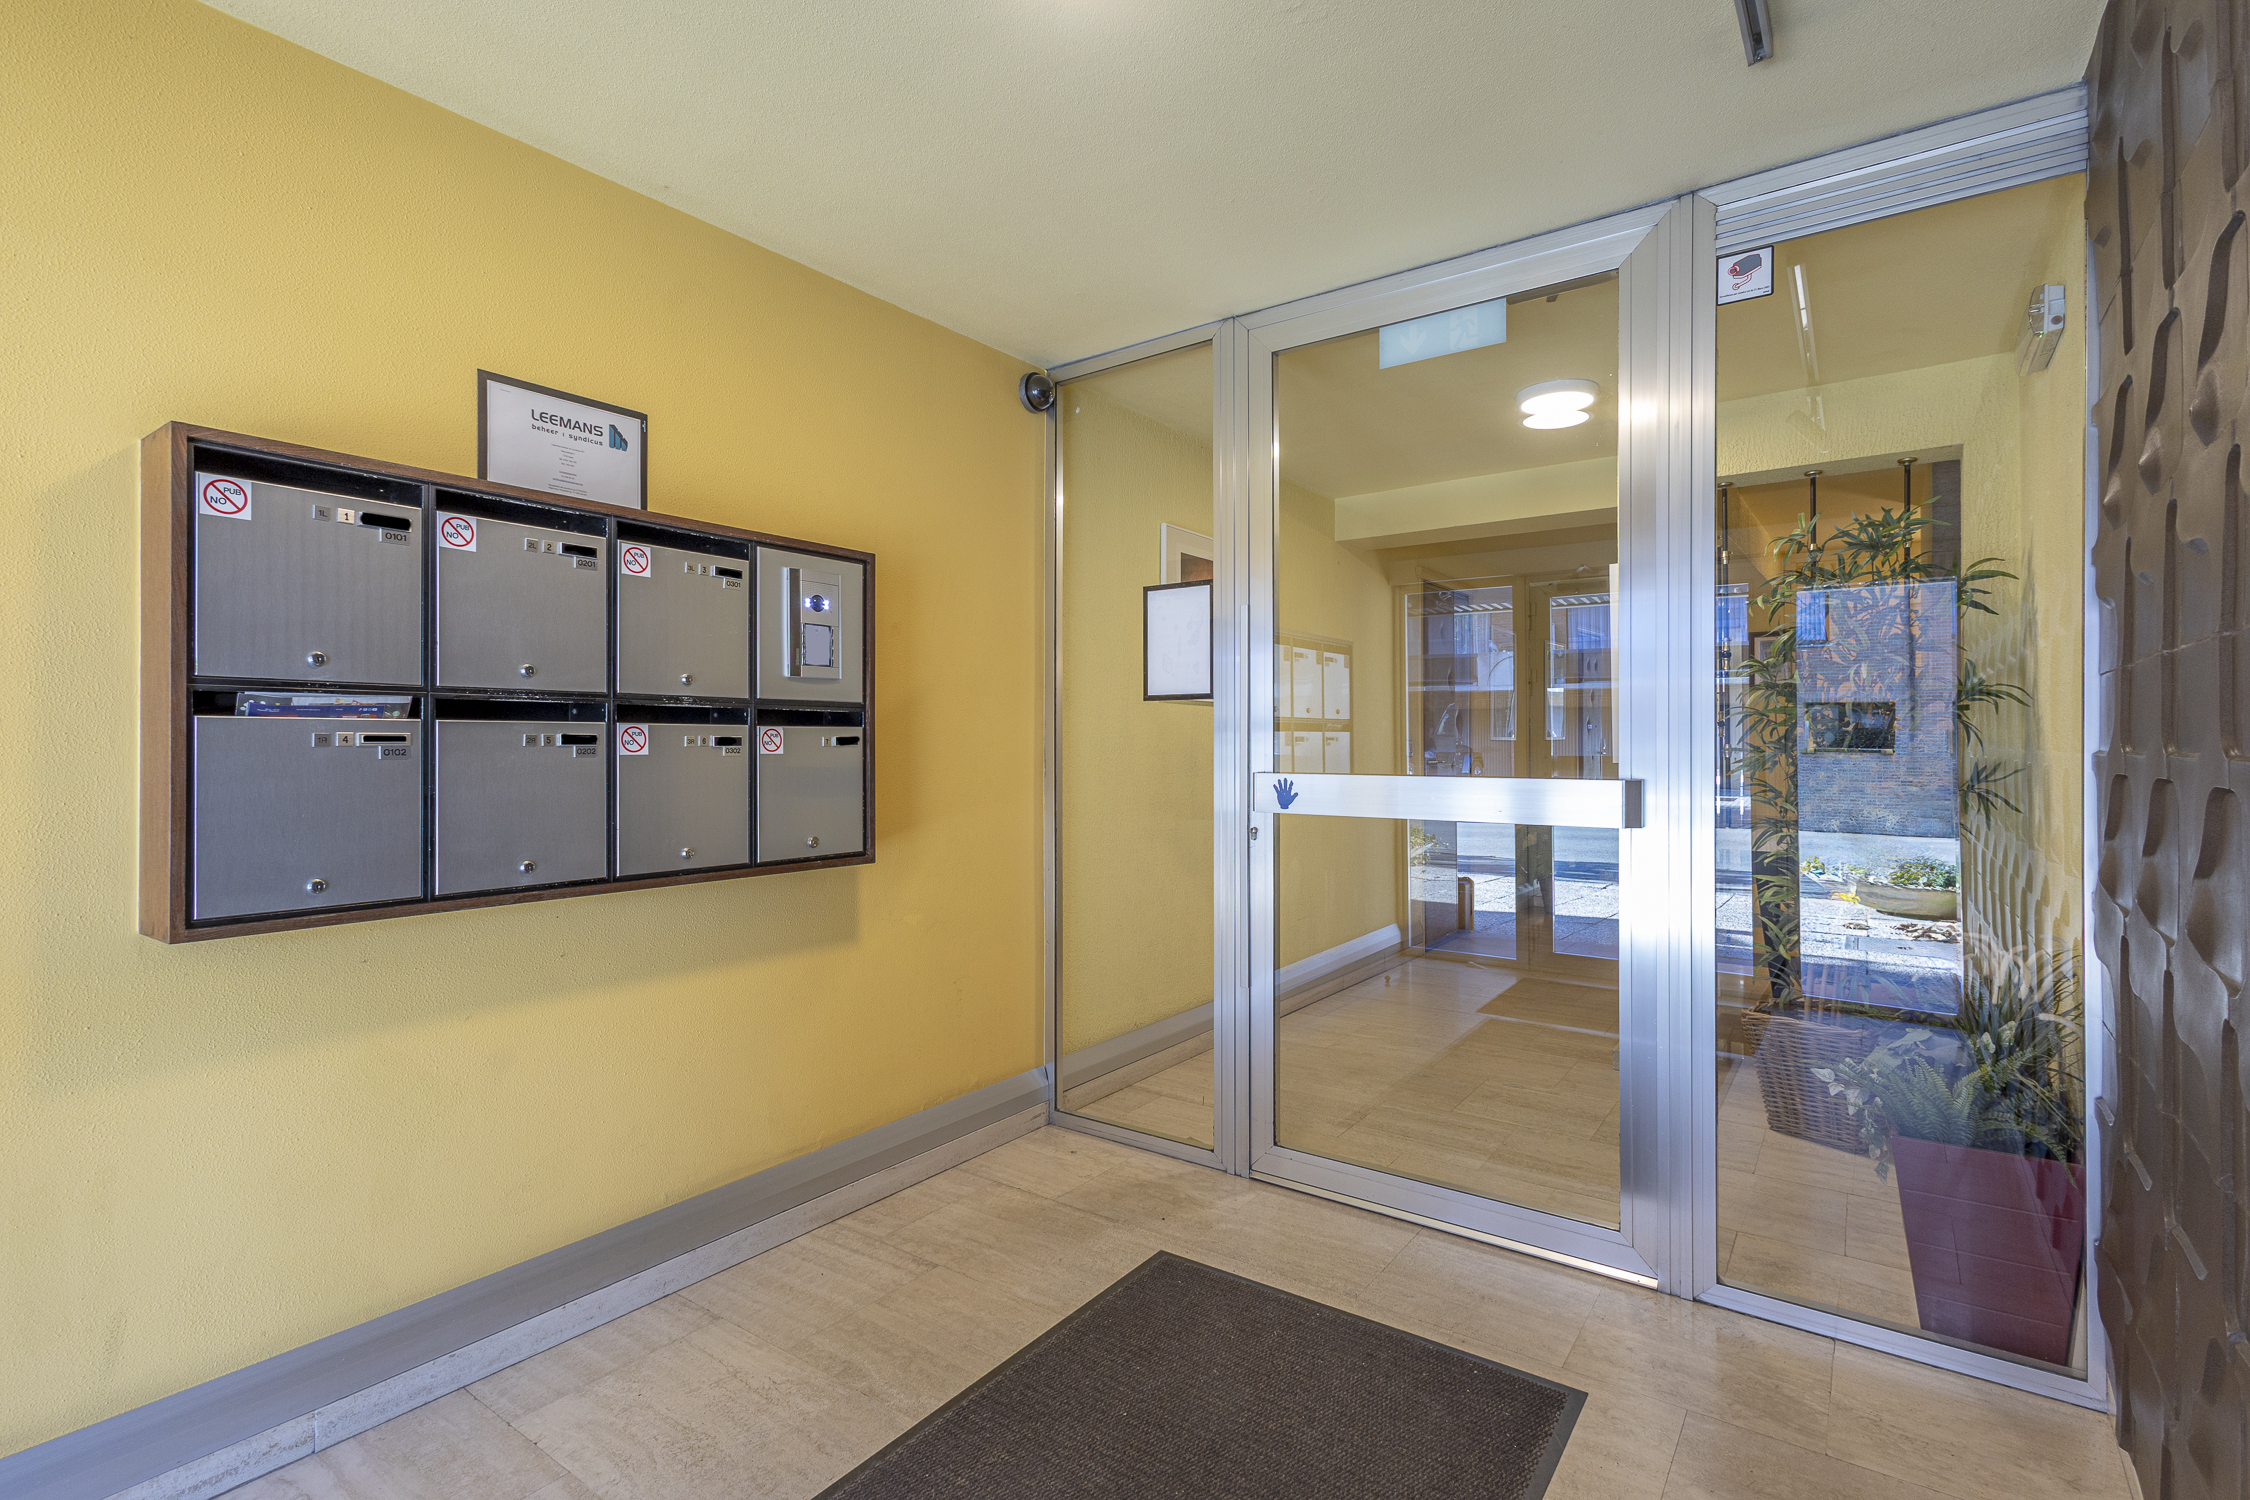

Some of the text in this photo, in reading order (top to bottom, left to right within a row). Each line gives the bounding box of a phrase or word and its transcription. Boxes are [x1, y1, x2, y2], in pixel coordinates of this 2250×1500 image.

[531, 408, 604, 437] LEEMANS
[532, 423, 604, 446] beheer syndicus
[223, 486, 242, 496] PUB
[210, 495, 227, 505] NO
[318, 509, 328, 518] 1L
[344, 512, 349, 521] 1
[456, 523, 470, 531] PUB
[385, 532, 407, 542] 0101
[446, 531, 459, 539] NO
[528, 541, 537, 550] 2L
[546, 543, 552, 551] 2
[633, 551, 645, 559] PUB
[577, 558, 596, 568] 0201
[726, 580, 741, 588] 0301
[342, 735, 349, 743] 4
[546, 736, 552, 744] 5
[702, 737, 707, 745] 6
[383, 748, 407, 756] 0102
